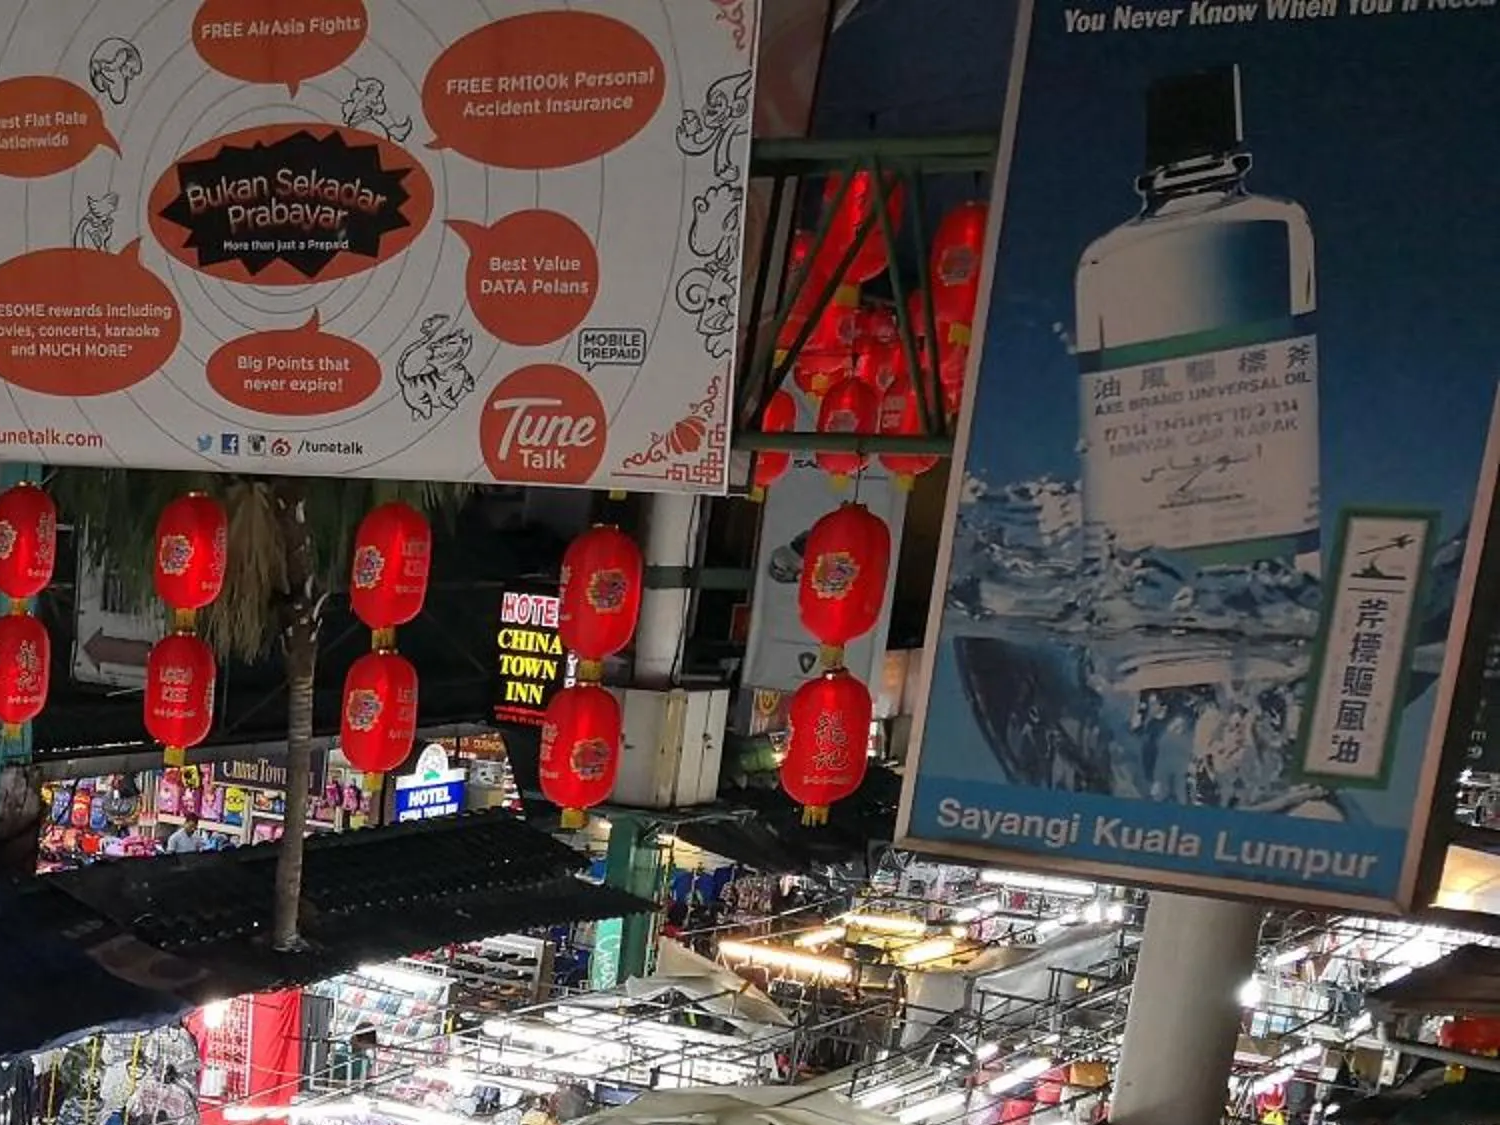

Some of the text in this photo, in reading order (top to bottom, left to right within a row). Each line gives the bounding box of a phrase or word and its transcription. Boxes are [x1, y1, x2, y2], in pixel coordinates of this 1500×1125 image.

[1065, 10, 1105, 33] You
[1113, 5, 1182, 31] Never
[1189, 0, 1257, 26] Know
[1266, 0, 1337, 20] When
[201, 22, 244, 40] FREE
[248, 17, 305, 37] AirAsia
[446, 68, 655, 95] FREE RM100k Personal
[463, 95, 633, 118] Accident Insurance
[24, 112, 51, 129] Flat
[55, 111, 88, 127] Rate
[186, 167, 388, 210] Bukan Sekadar
[228, 197, 350, 235] Prabayar
[223, 239, 249, 251] More
[251, 239, 274, 251] than
[277, 239, 298, 252] just
[307, 239, 349, 252] Prepaid
[489, 256, 580, 272] Best Value
[480, 279, 524, 295] DATA
[48, 303, 103, 318] rewards
[106, 303, 172, 320] including
[39, 324, 101, 340] concerts,
[105, 323, 160, 338] karaoke
[583, 333, 640, 347] MOBILE
[11, 343, 37, 357] and
[39, 343, 82, 357] MUCH
[583, 346, 641, 361] PREPAID
[237, 356, 350, 373] Big Points that
[244, 378, 343, 394] never expire!
[1189, 377, 1281, 401] UNIVERSAL
[1285, 371, 1313, 385] OIL
[493, 397, 598, 461] Tune
[518, 448, 566, 470] Talk
[501, 592, 560, 628] HOTE
[498, 629, 563, 654] CHINA
[500, 654, 558, 680] TOWN
[505, 681, 544, 705] INN
[408, 785, 452, 808] HOTEL
[937, 798, 1378, 881] Sayangi Kuala Lumpur
